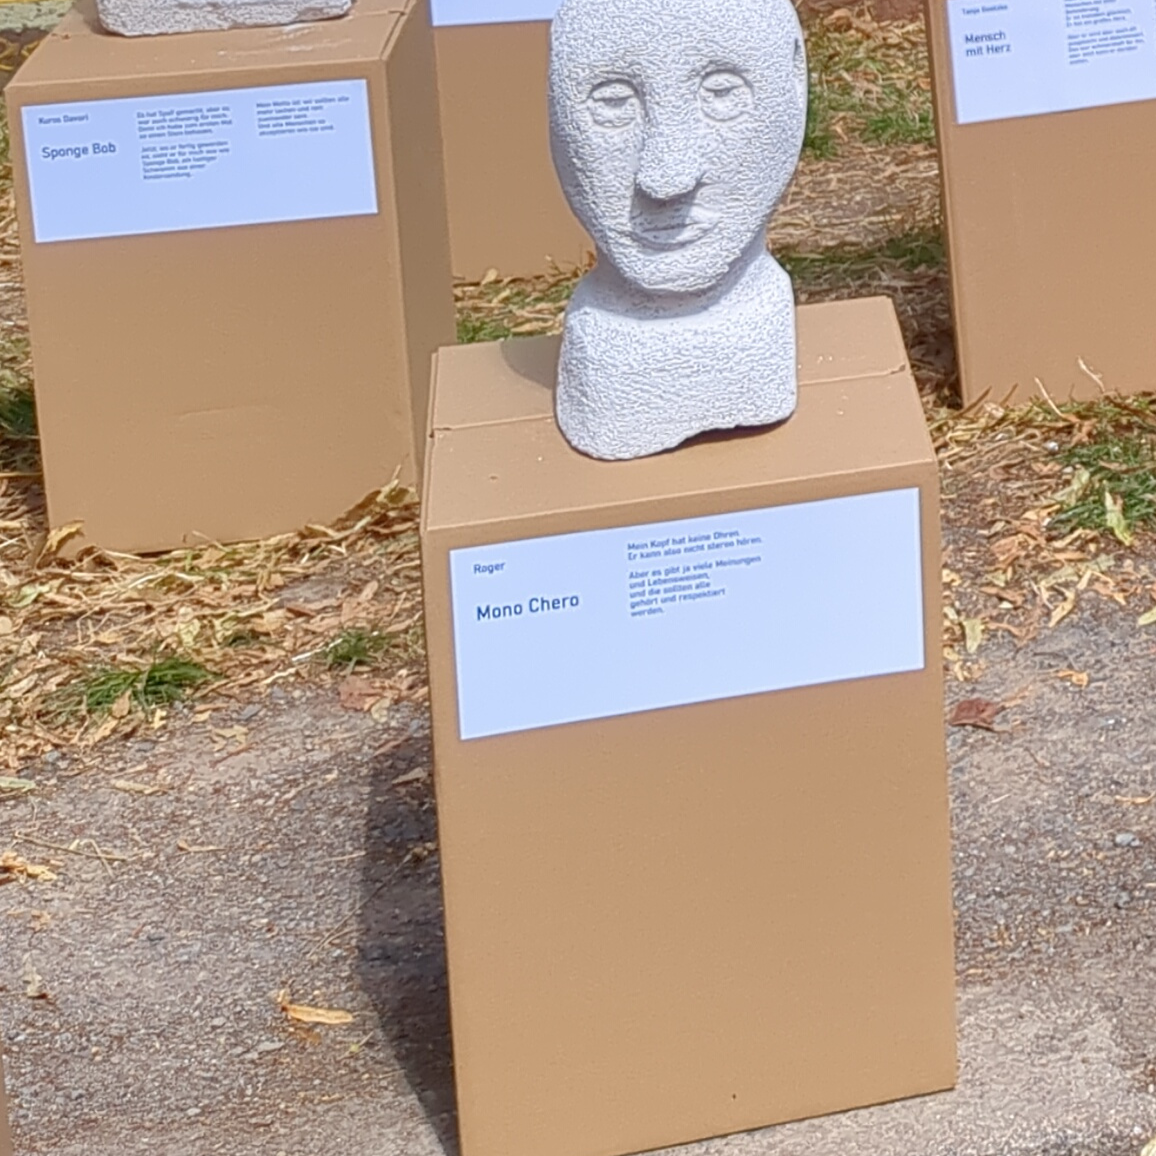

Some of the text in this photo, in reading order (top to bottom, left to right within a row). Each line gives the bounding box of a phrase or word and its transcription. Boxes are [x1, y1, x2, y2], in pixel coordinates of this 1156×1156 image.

[965, 30, 1006, 44] Mensch
[966, 44, 1011, 57] mit Herz
[42, 142, 116, 160] Sponge Bob
[473, 563, 505, 574] Roger
[477, 596, 579, 620] Mono Chero
